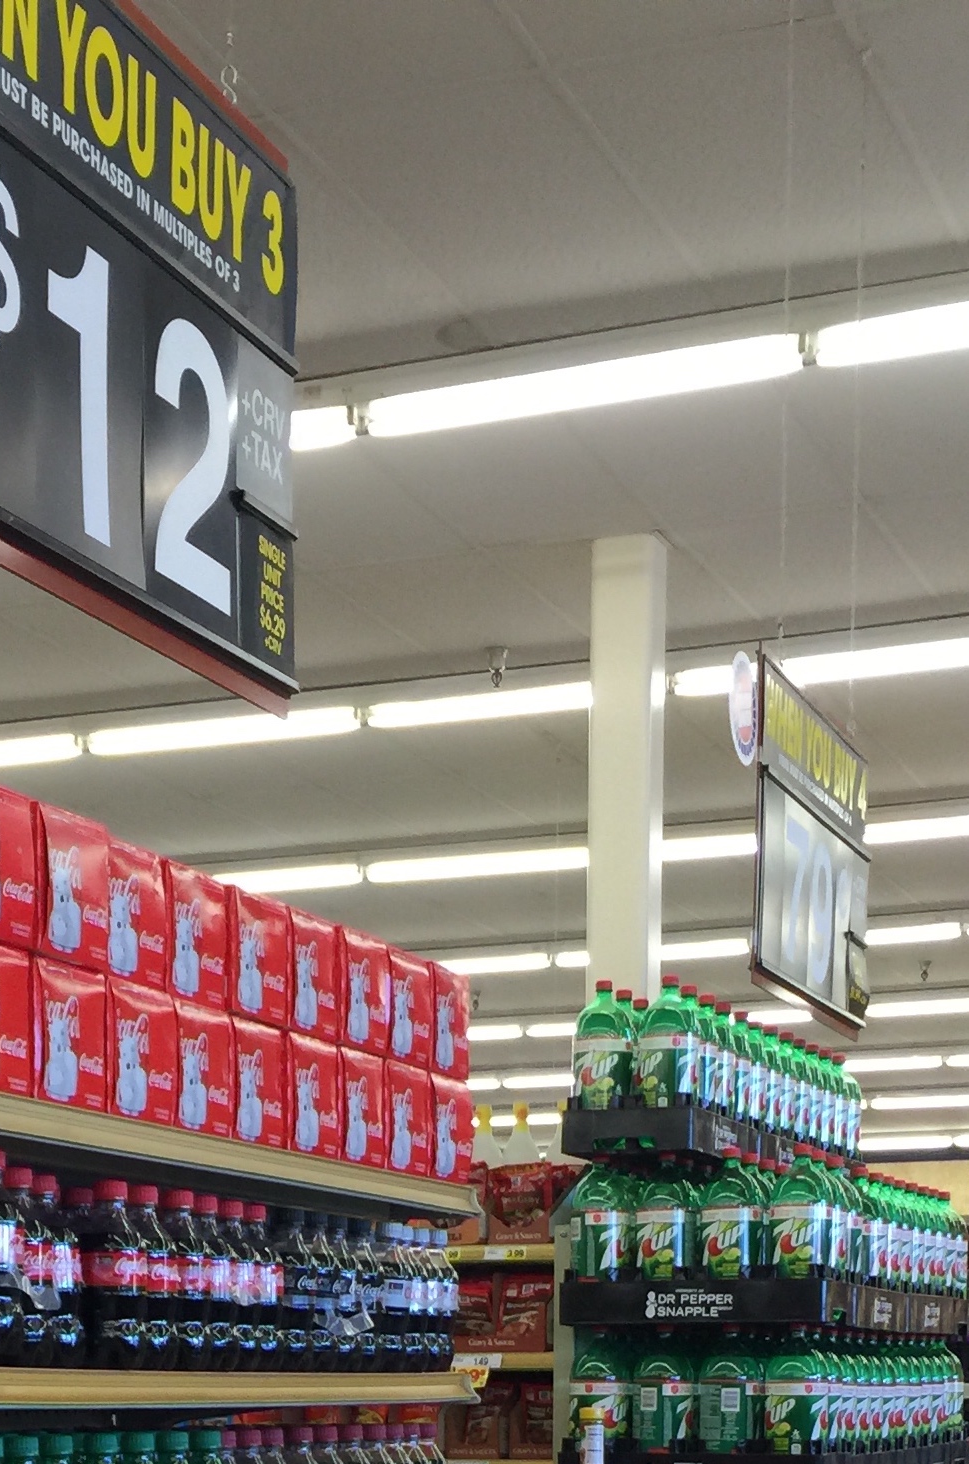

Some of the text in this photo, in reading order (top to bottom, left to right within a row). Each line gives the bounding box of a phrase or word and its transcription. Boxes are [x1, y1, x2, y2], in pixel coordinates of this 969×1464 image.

[56, 3, 156, 178] YOU
[172, 97, 251, 263] BUY
[261, 191, 284, 295] 3
[32, 93, 49, 129] BE
[53, 112, 133, 197] PURCHASED
[136, 187, 150, 216] IN
[153, 201, 212, 268] MULTIPLES
[214, 258, 231, 283] OF
[232, 275, 240, 292] 3
[259, 534, 285, 570] SINGLE
[263, 561, 282, 587] UNIT
[260, 580, 284, 614] PRICE
[259, 605, 285, 641] $6.29
[806, 715, 831, 789] YOU
[833, 742, 857, 817] BUY
[657, 1307, 718, 1317] SNAPPLE
[658, 1294, 733, 1304] DR PEPPER
